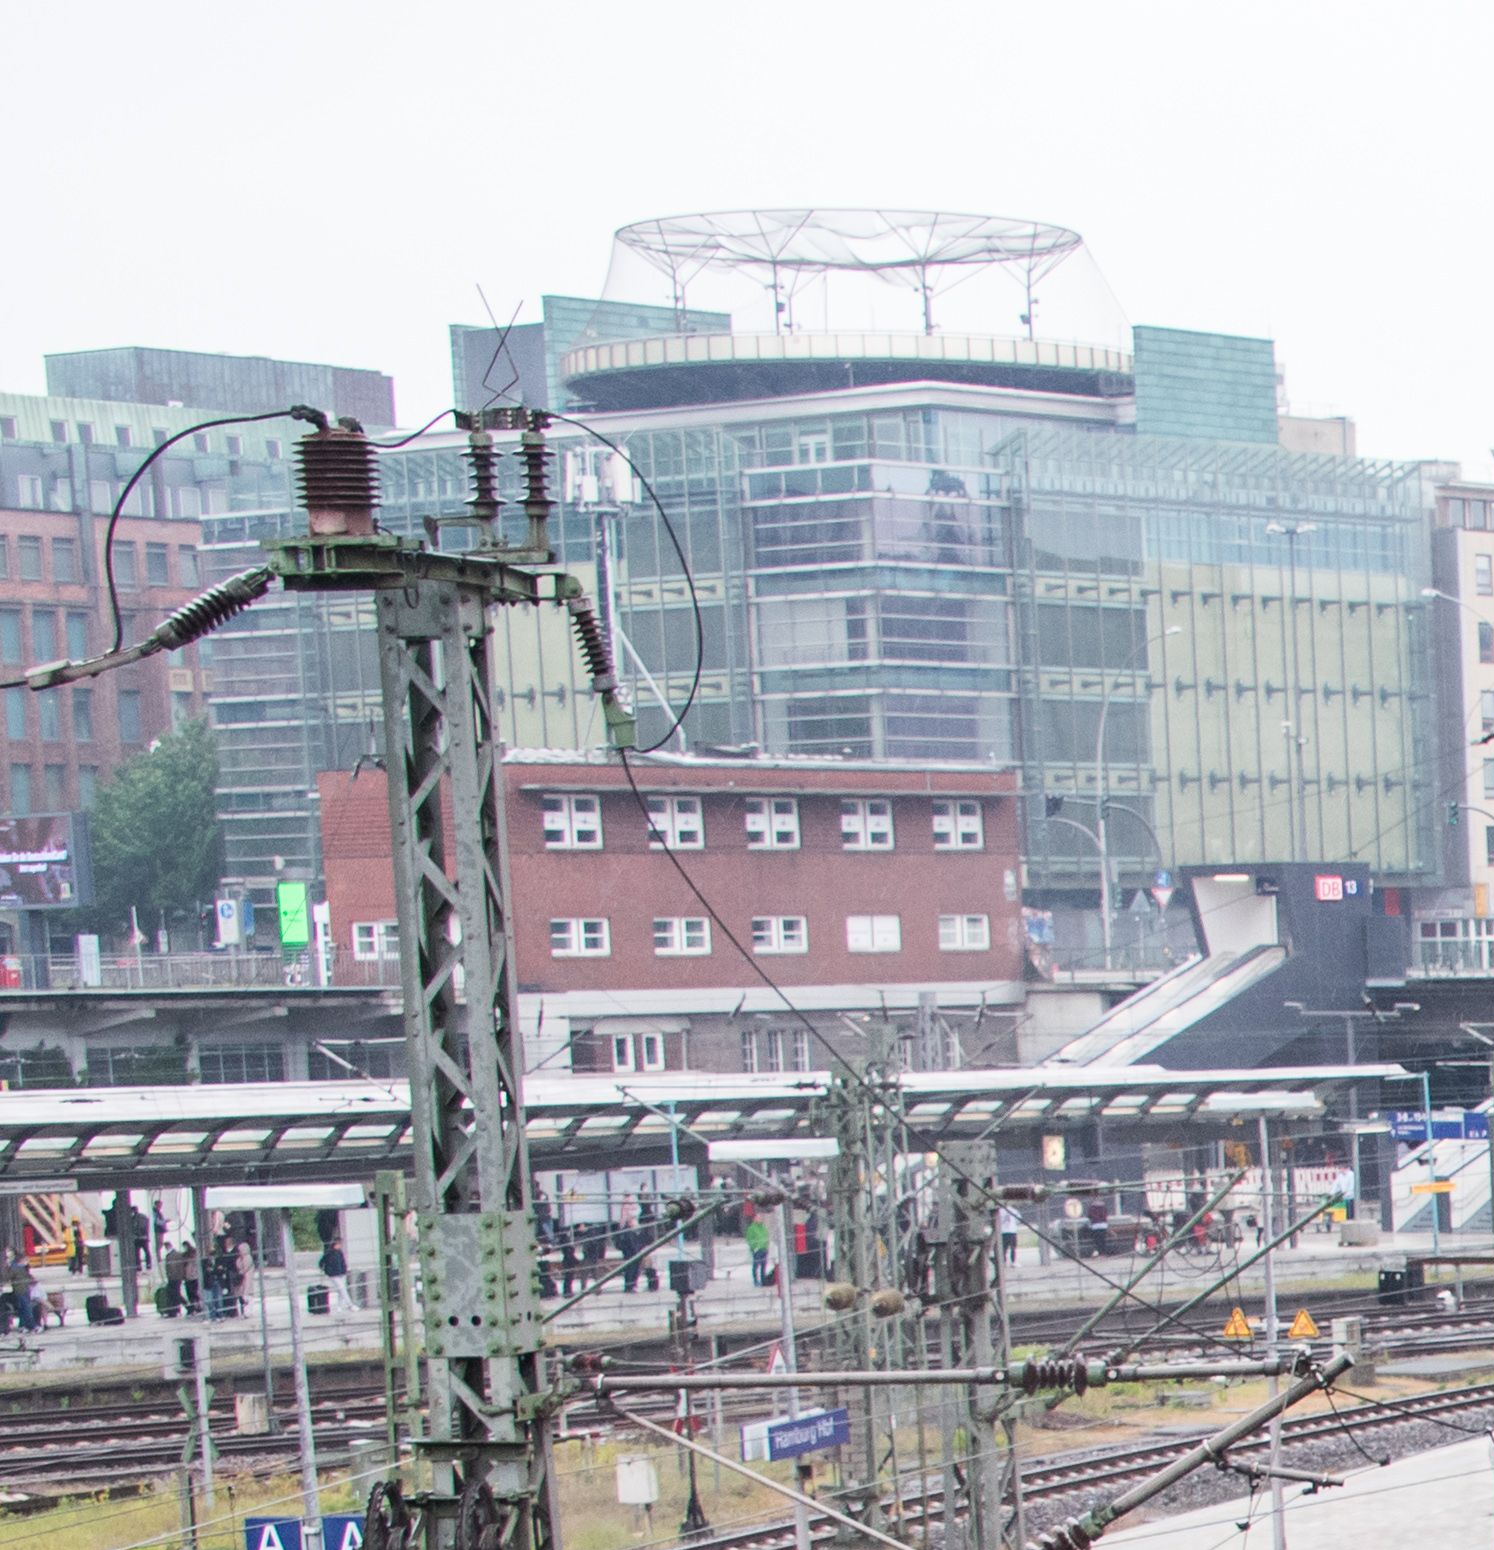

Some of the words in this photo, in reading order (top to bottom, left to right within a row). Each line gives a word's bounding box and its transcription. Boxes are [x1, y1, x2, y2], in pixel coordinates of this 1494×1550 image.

[1322, 884, 1342, 898] DB
[1344, 880, 1357, 895] 13
[775, 1425, 817, 1450] Hamburg
[818, 1416, 834, 1438] Hbf
